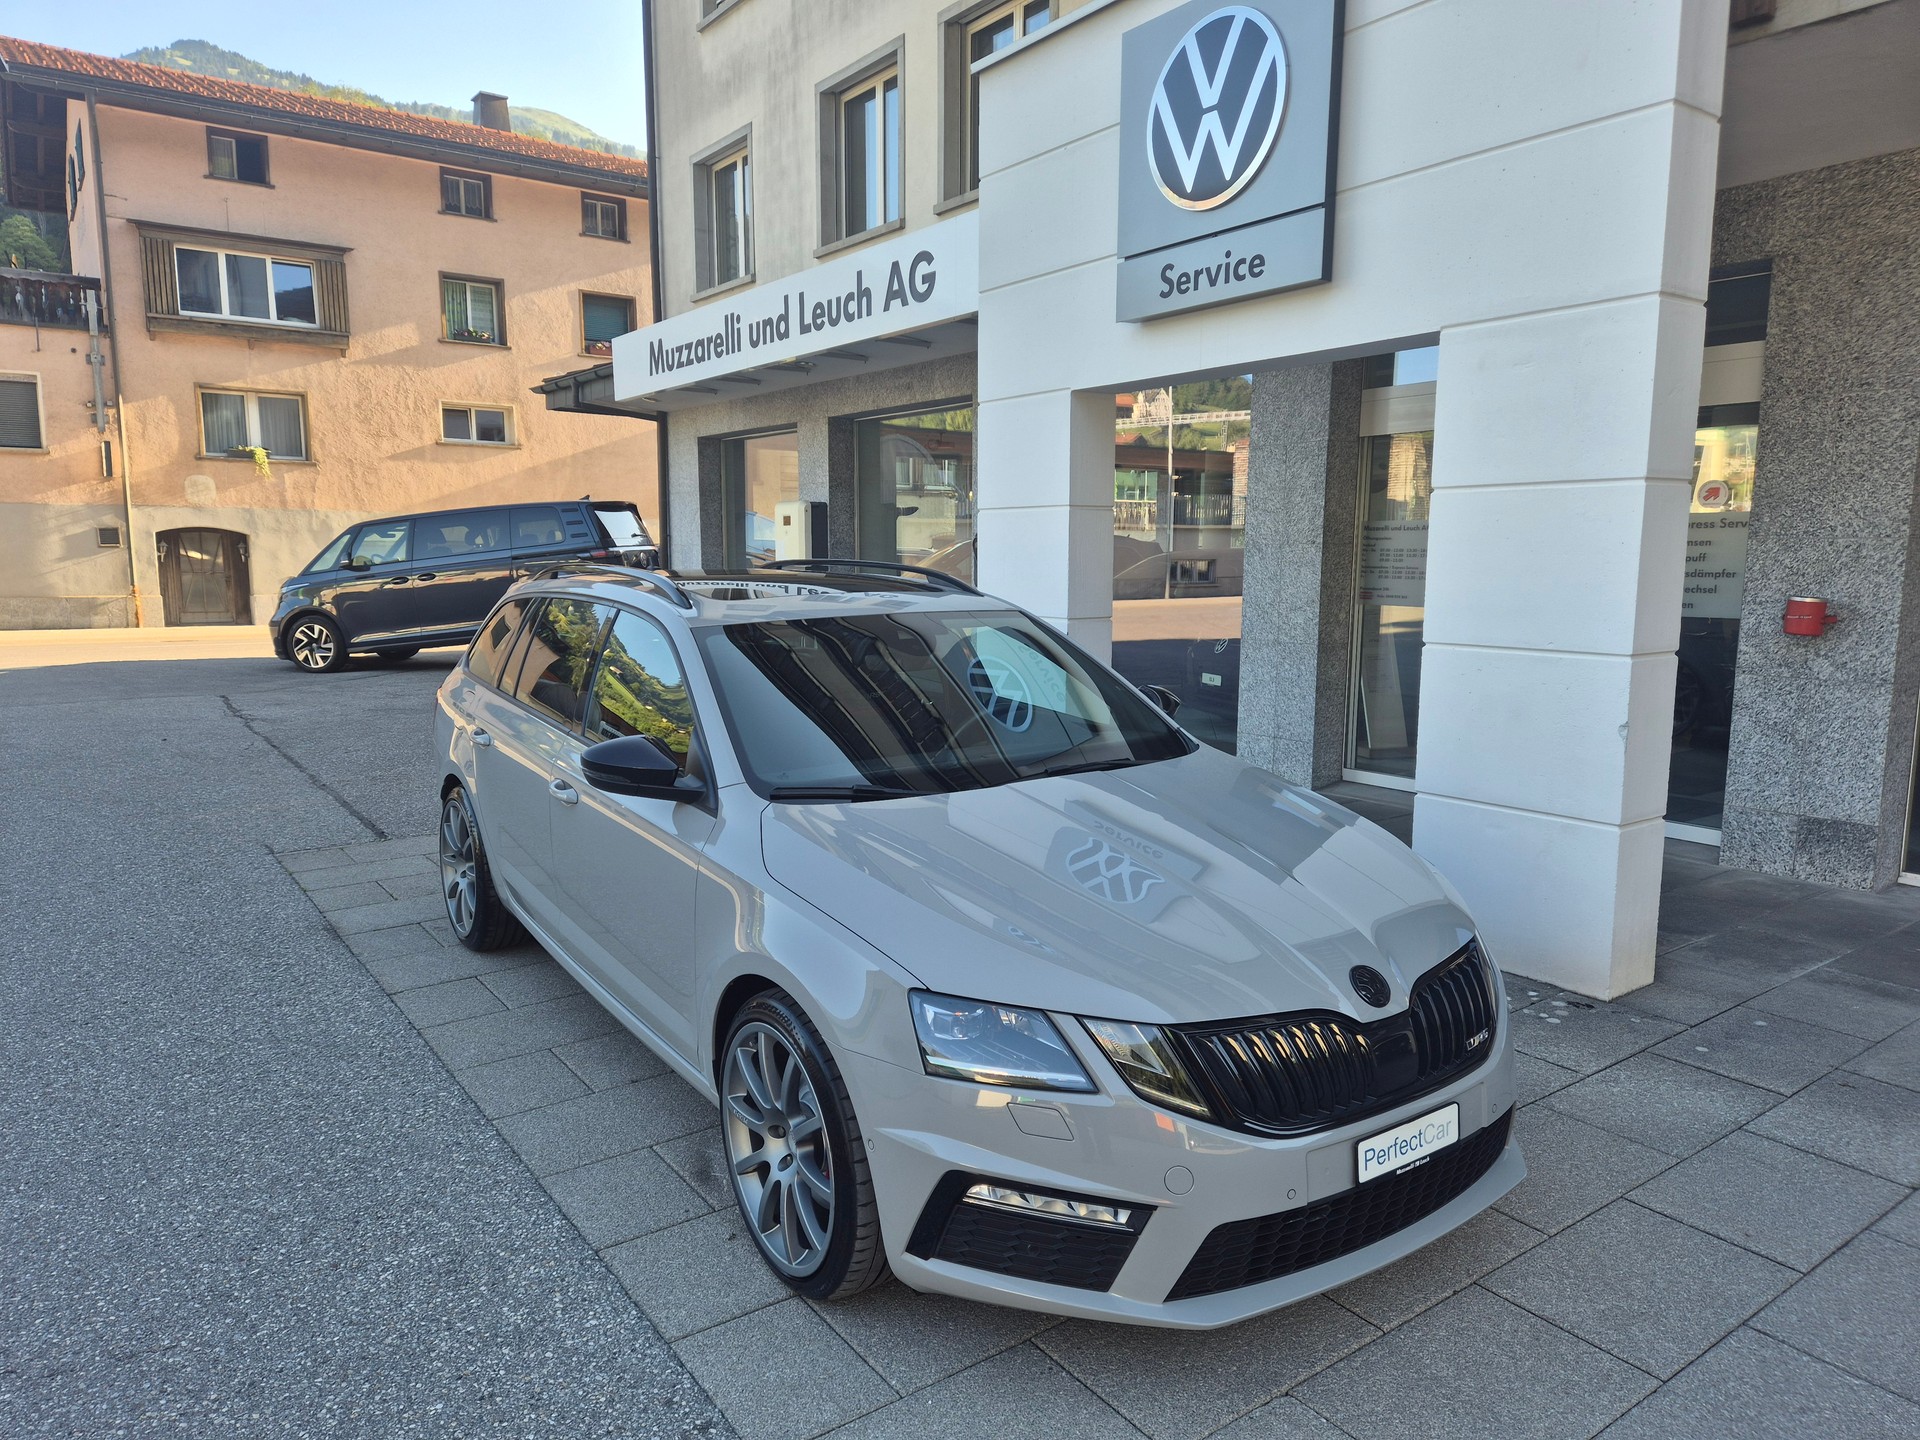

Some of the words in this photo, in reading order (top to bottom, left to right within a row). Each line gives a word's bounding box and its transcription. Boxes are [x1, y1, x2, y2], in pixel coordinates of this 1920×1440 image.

[1159, 250, 1266, 299] Service
[649, 313, 742, 377] Muzzarelli
[749, 294, 790, 349] und
[799, 270, 872, 336] Leuch
[883, 250, 937, 313] AG
[1684, 585, 1718, 594] echsel
[1364, 1120, 1452, 1172] PerfectCar
